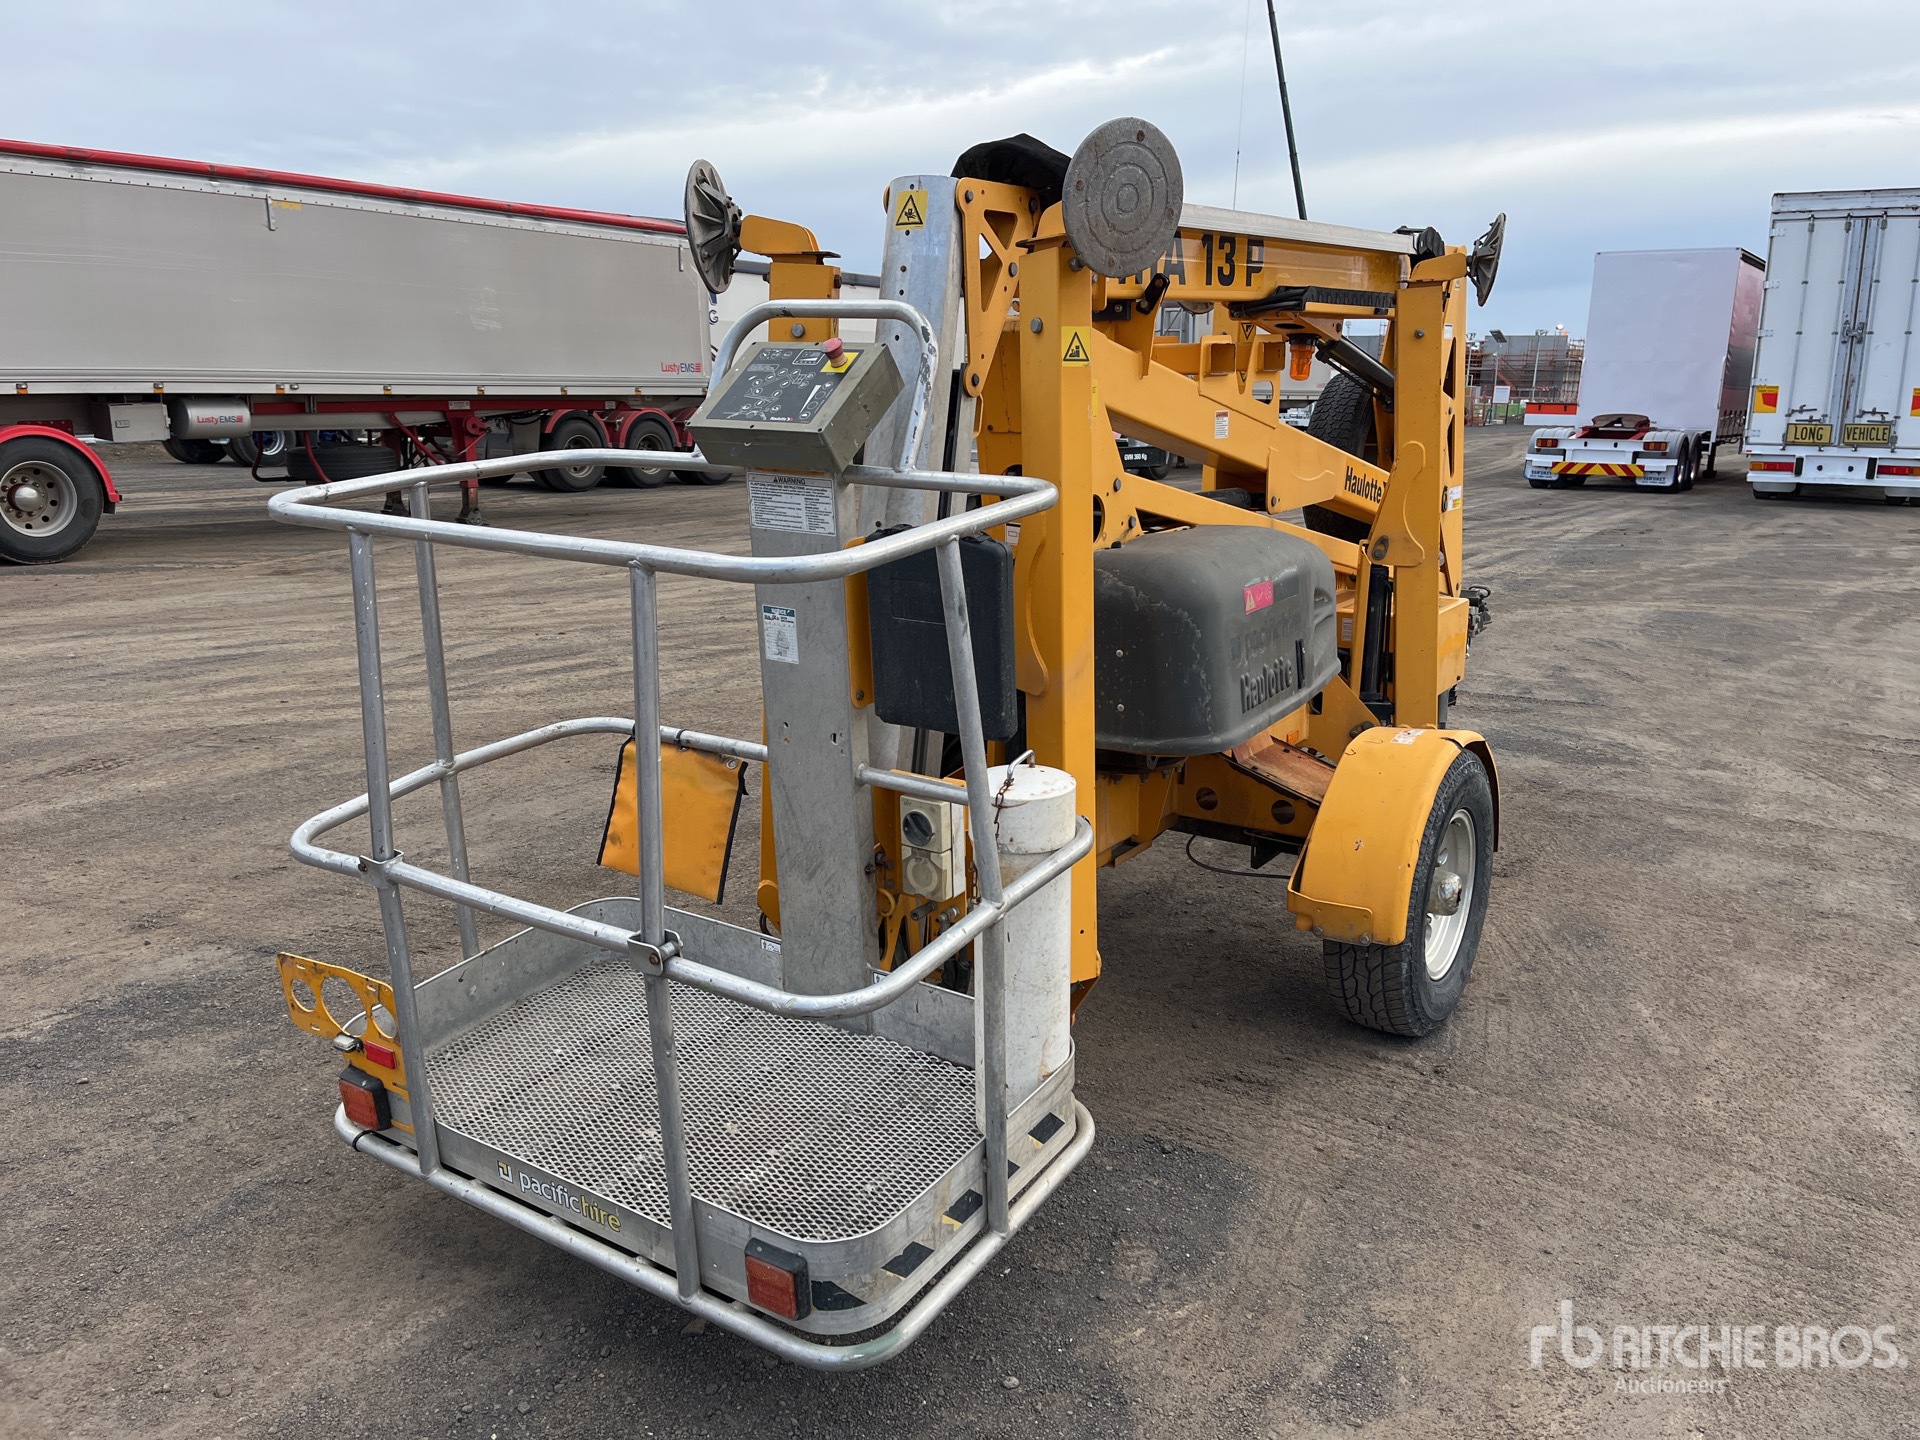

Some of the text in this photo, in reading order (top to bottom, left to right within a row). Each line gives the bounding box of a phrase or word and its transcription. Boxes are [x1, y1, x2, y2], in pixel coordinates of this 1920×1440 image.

[1202, 233, 1236, 287] 13
[1246, 238, 1265, 287] P
[1794, 425, 1888, 442] LONG VEHICLE
[778, 476, 806, 485] WARNING
[1344, 465, 1382, 504] Haulotte
[1240, 656, 1292, 714] Haulotte
